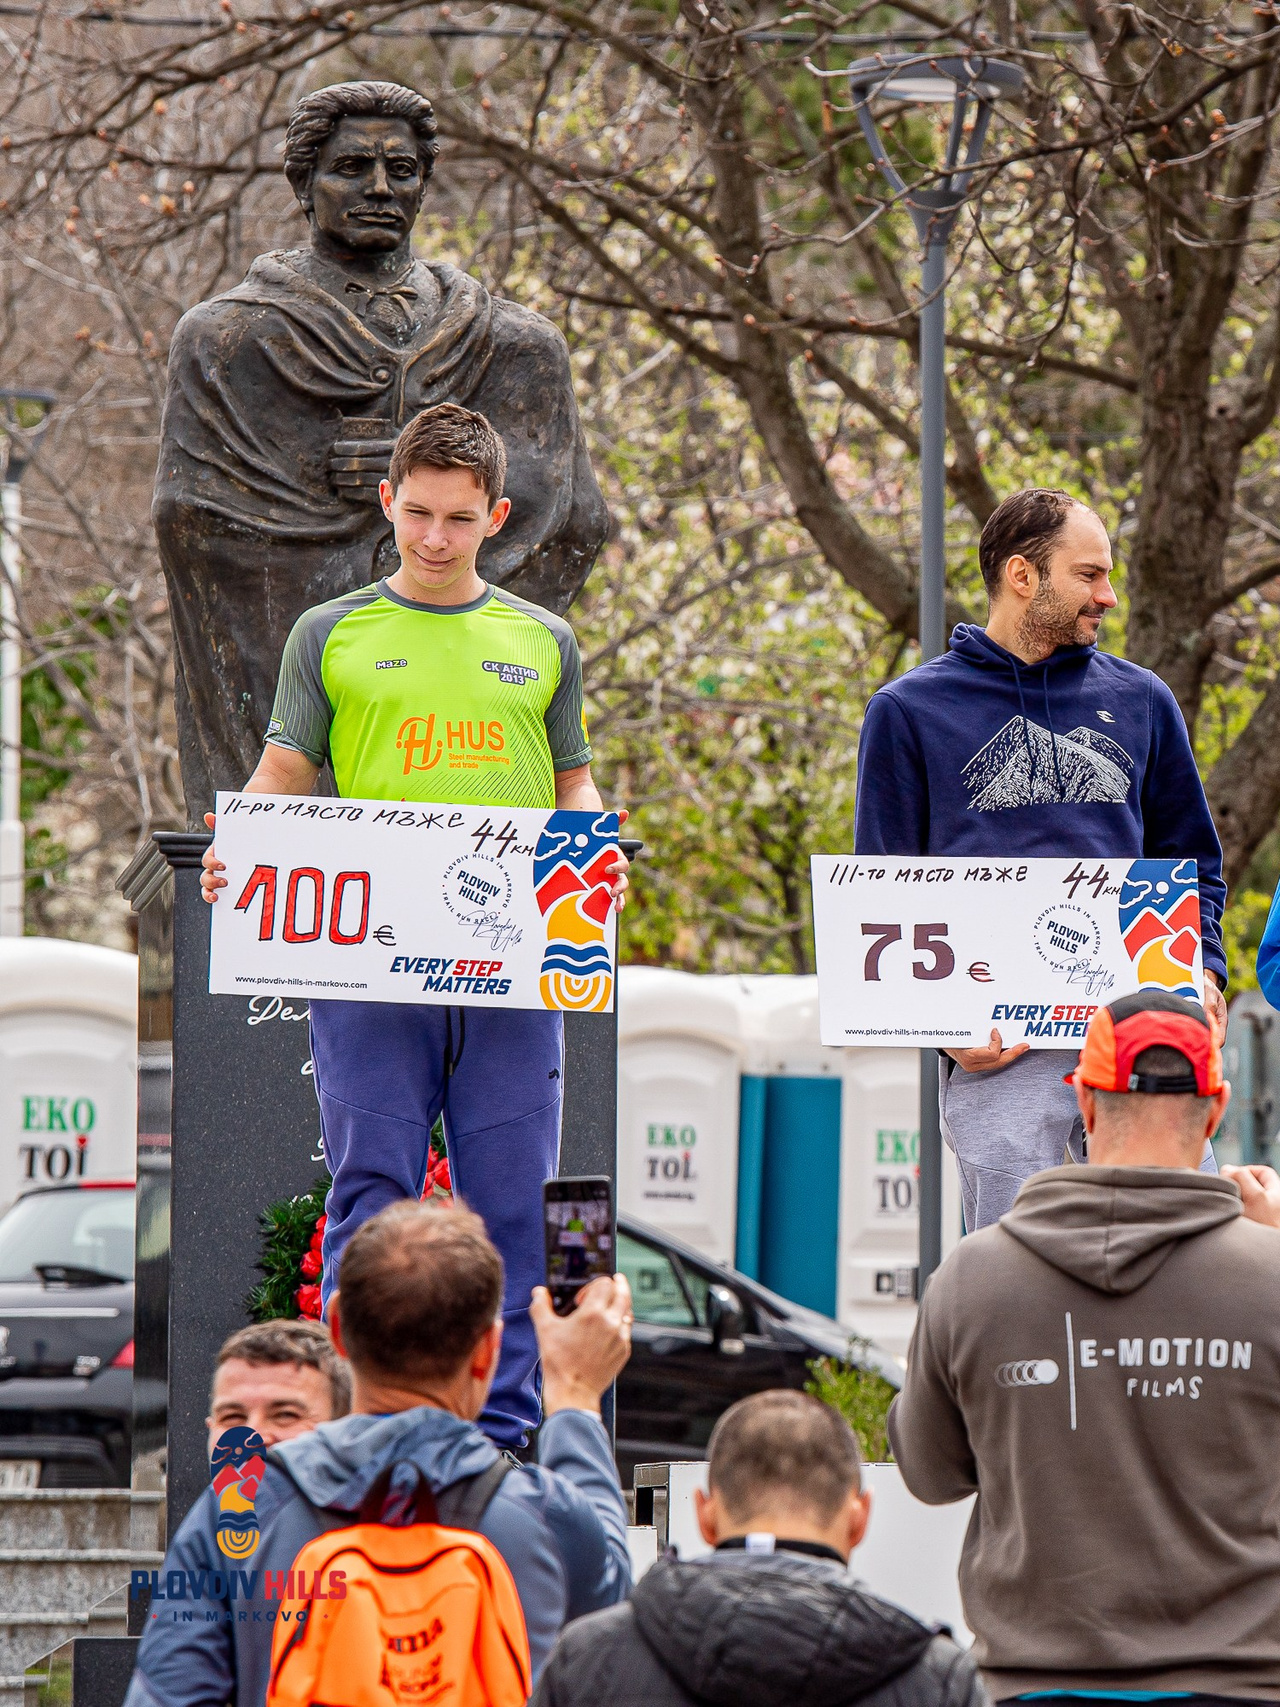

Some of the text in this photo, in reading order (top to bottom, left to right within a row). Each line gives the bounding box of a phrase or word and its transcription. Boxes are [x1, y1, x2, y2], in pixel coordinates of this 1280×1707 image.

[500, 673, 525, 684] 2013
[503, 665, 538, 679] АКТИВ
[446, 721, 505, 751] HUS
[466, 754, 510, 765] manufacturing
[443, 854, 469, 879] PLOVDIV
[472, 853, 495, 862] HILLS
[457, 870, 500, 897] PLOVDIV
[458, 885, 488, 906] HILLS
[234, 864, 371, 945] 100
[1033, 905, 1056, 930] PLOVDIV
[1059, 904, 1081, 912] HILLS
[1046, 920, 1090, 945] PLOVDIV
[1049, 935, 1078, 954] HILLS
[860, 922, 956, 982] 75
[389, 956, 503, 976] EVERY STEP
[235, 975, 368, 989] www.plovdiv-hills-in-markovo.com
[422, 975, 512, 995] MATTERS
[991, 1004, 1052, 1020] EVERY
[845, 1028, 972, 1037] www.plovdiv-hills-in-markovo.com
[22, 1095, 97, 1134] EKO
[646, 1122, 697, 1147] EKO
[1079, 1337, 1252, 1370] E-MOTION
[1126, 1375, 1203, 1400] FILMS
